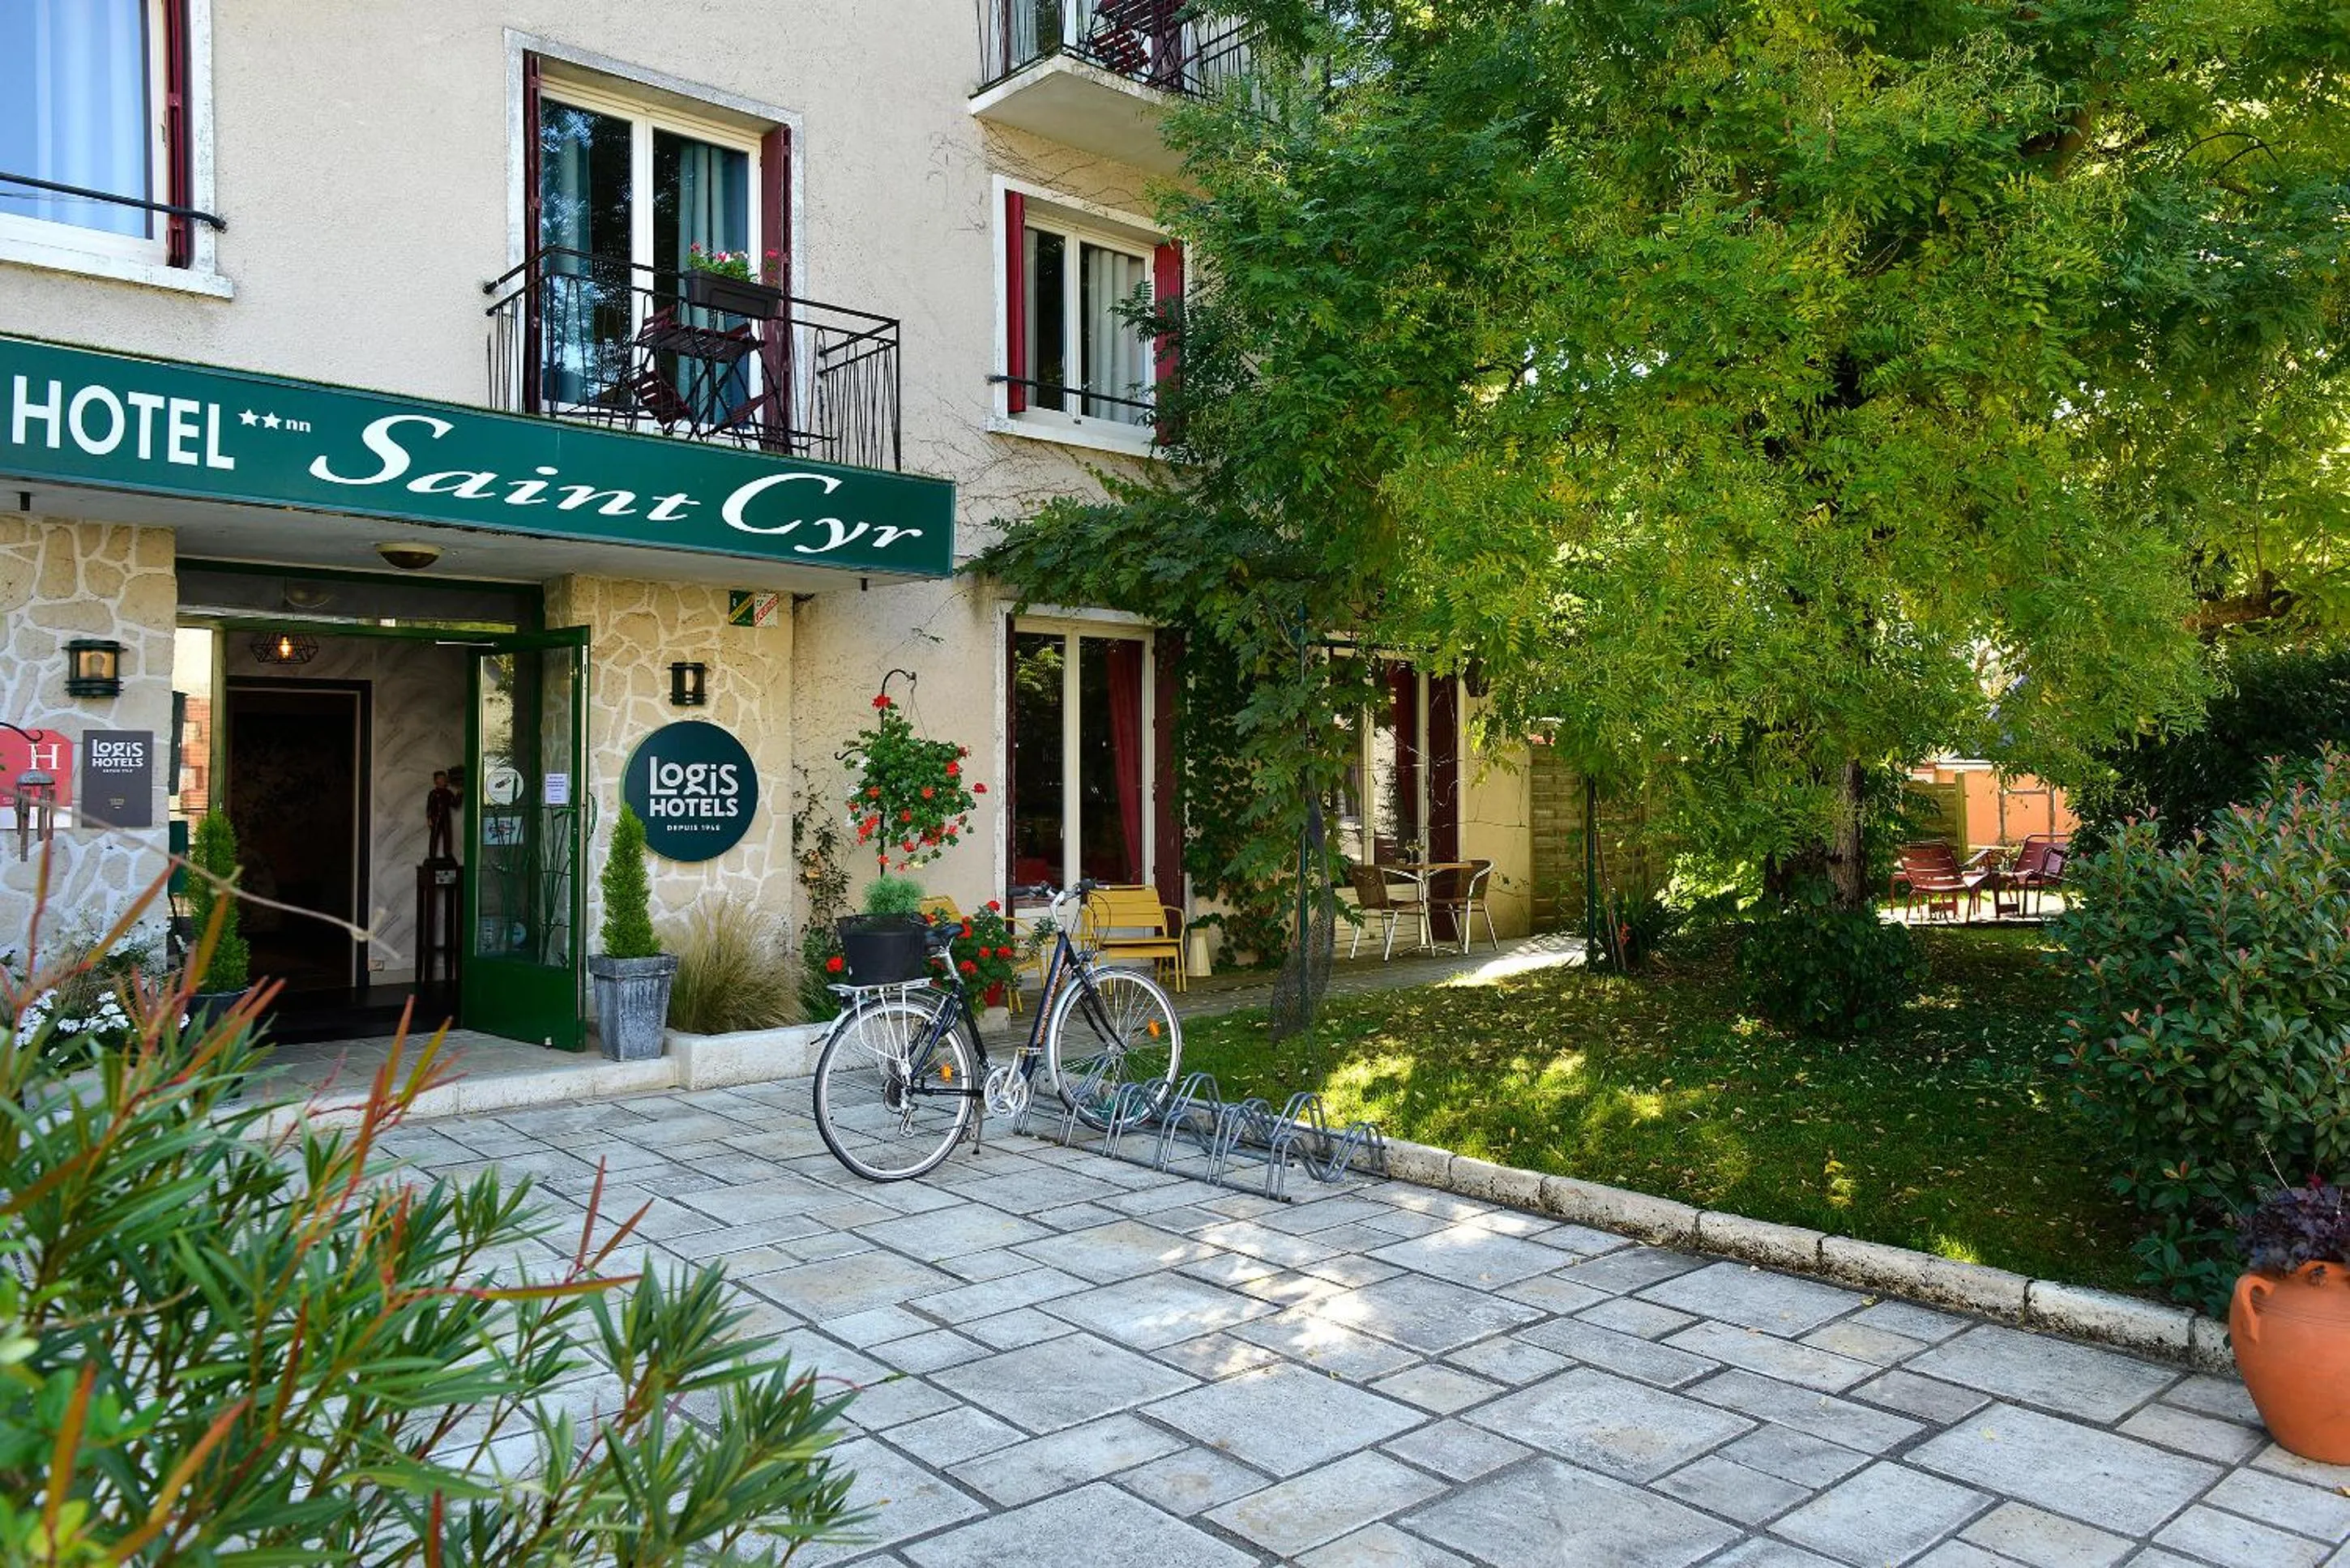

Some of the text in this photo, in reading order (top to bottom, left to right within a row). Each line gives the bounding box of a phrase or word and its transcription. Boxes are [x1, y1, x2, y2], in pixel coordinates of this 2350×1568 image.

[12, 375, 234, 470] HOTEL
[309, 414, 700, 521] Saint
[721, 472, 923, 553] Cyr
[27, 743, 62, 770] H
[92, 758, 143, 767] HOTELS
[649, 797, 739, 817] HOTELS
